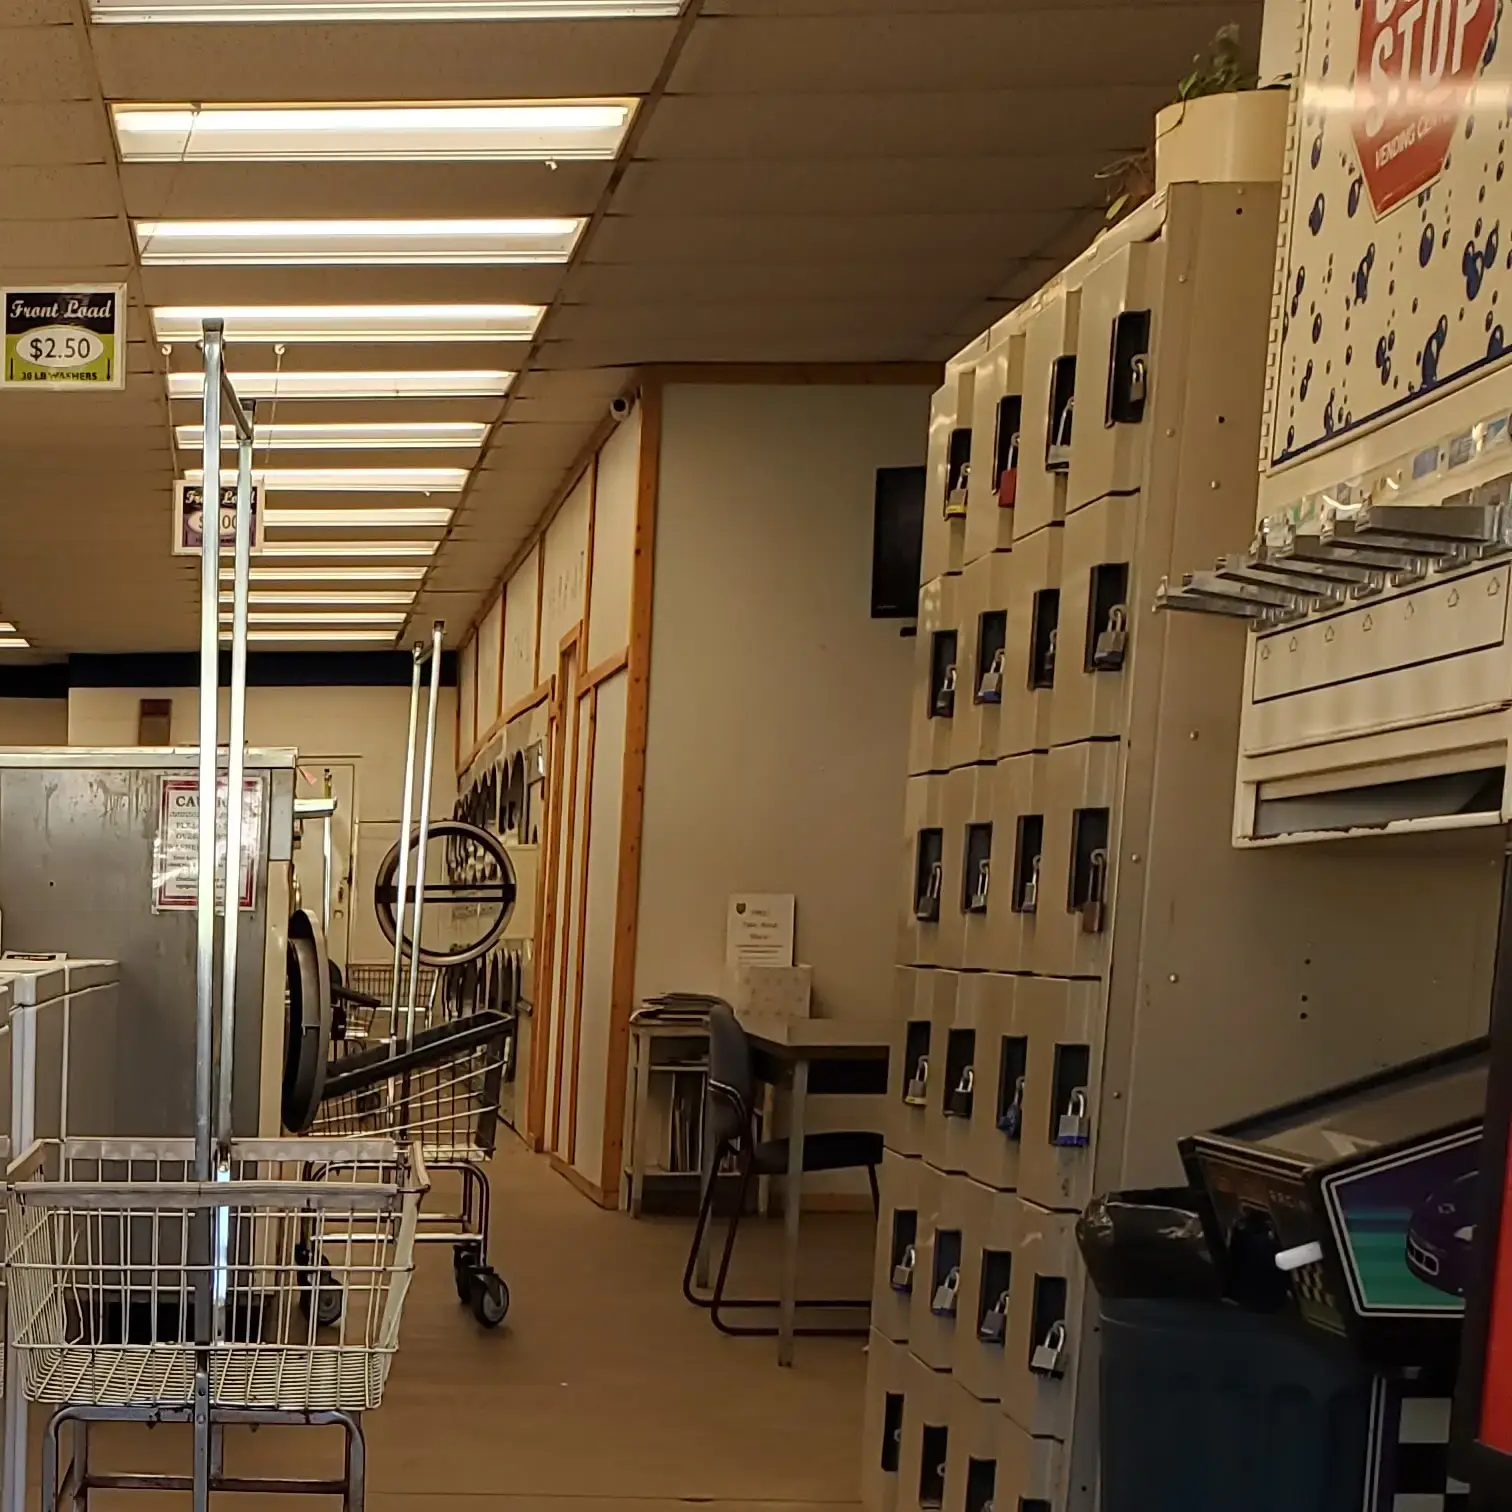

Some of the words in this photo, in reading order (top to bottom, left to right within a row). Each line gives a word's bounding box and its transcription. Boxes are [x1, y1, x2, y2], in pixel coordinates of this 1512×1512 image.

[1365, 0, 1481, 137] STOP
[1375, 122, 1416, 171] VENDING
[10, 300, 60, 319] Front
[63, 300, 112, 319] Load
[29, 338, 91, 361] $2.50
[34, 372, 47, 381] LB
